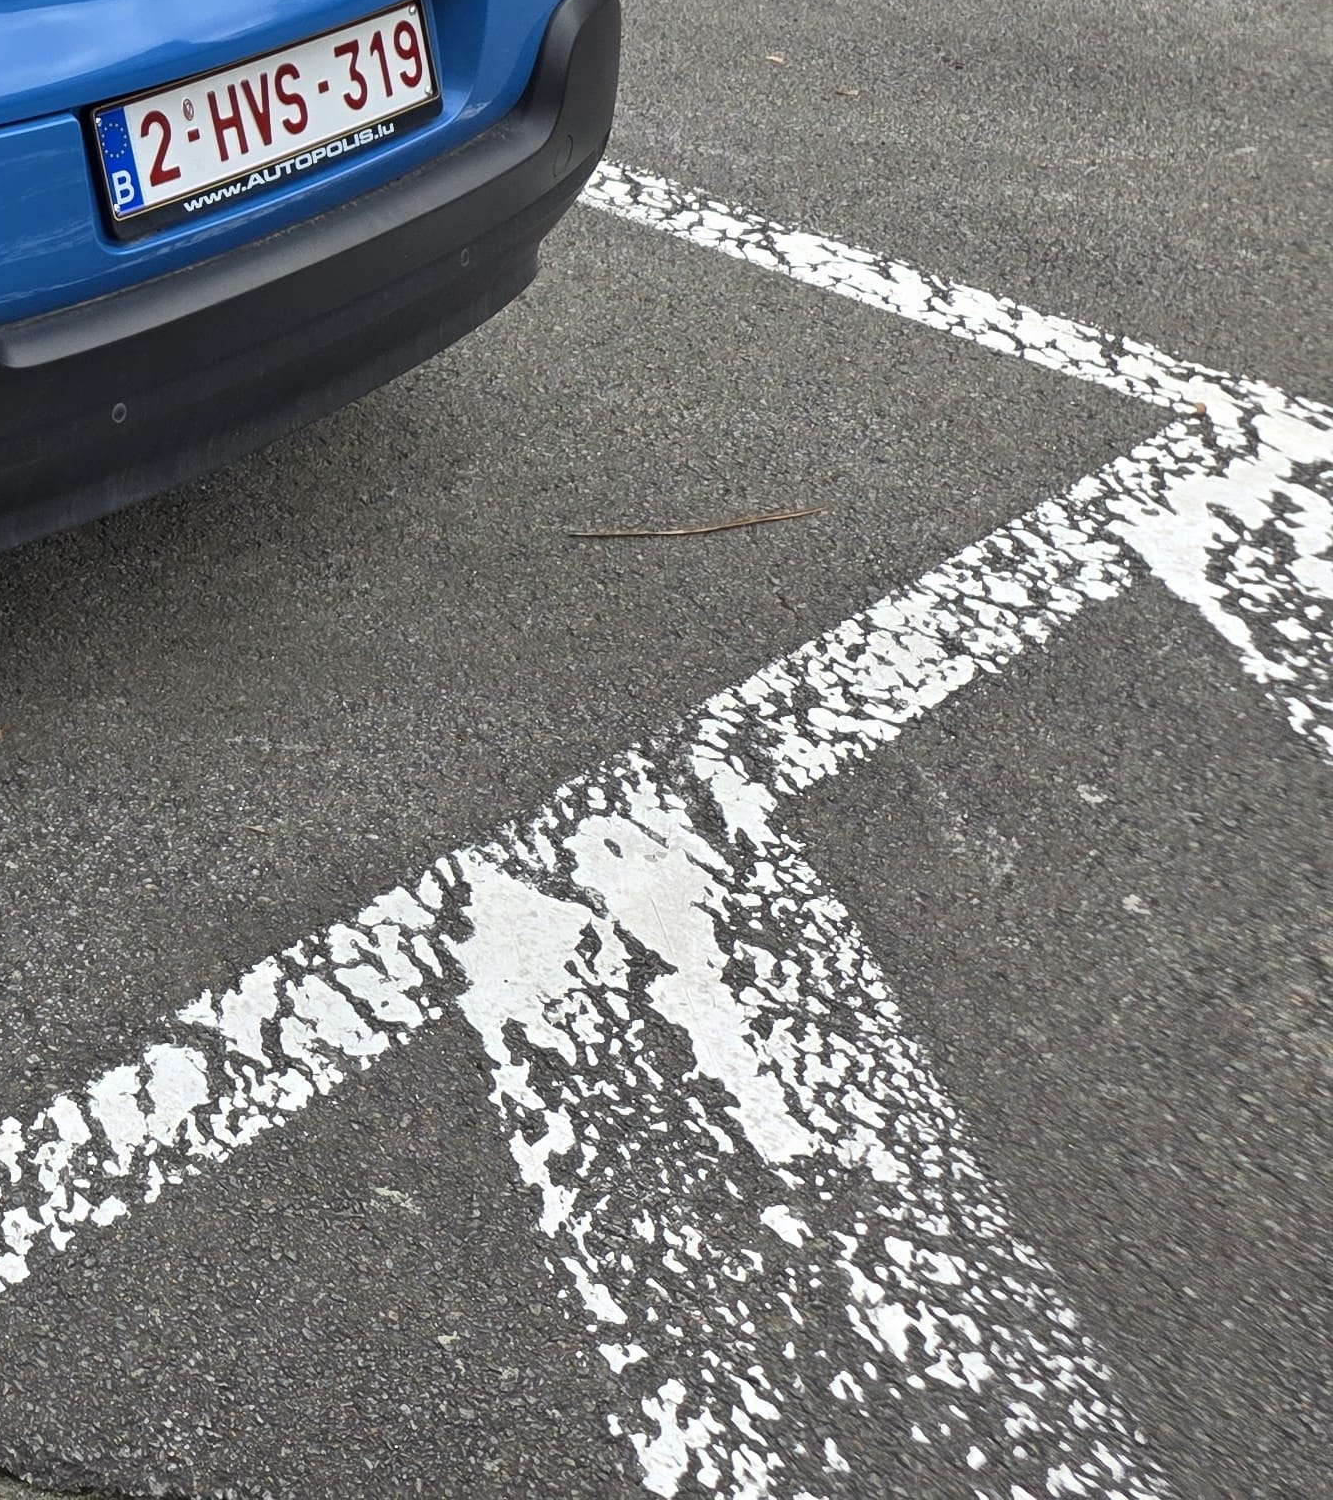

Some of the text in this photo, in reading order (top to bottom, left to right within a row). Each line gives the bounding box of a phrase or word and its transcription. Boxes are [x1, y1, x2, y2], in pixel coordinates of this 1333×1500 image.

[112, 19, 423, 206] B 2-HVS-319
[182, 119, 396, 213] www.AUTOPOLIS.lu
